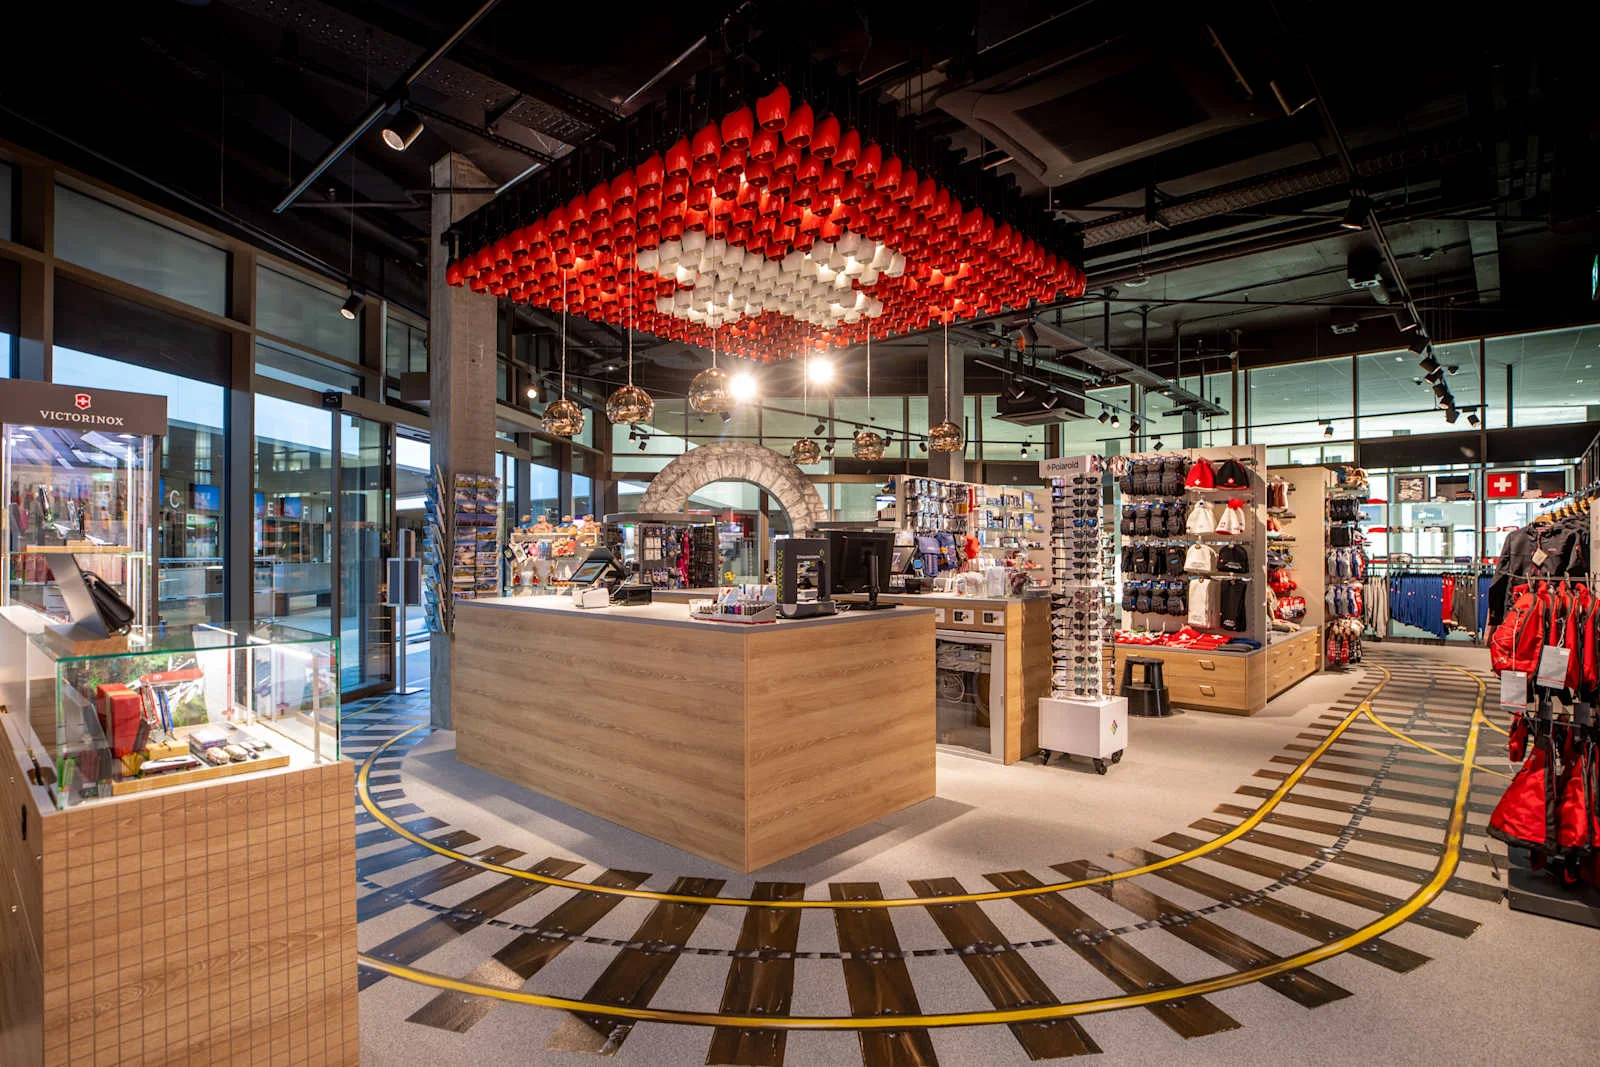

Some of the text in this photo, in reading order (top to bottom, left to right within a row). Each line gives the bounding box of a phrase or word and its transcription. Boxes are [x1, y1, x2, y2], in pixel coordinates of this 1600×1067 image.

[40, 410, 124, 426] VICTORINOX
[1051, 461, 1079, 471] Polaroid
[169, 489, 180, 509] C
